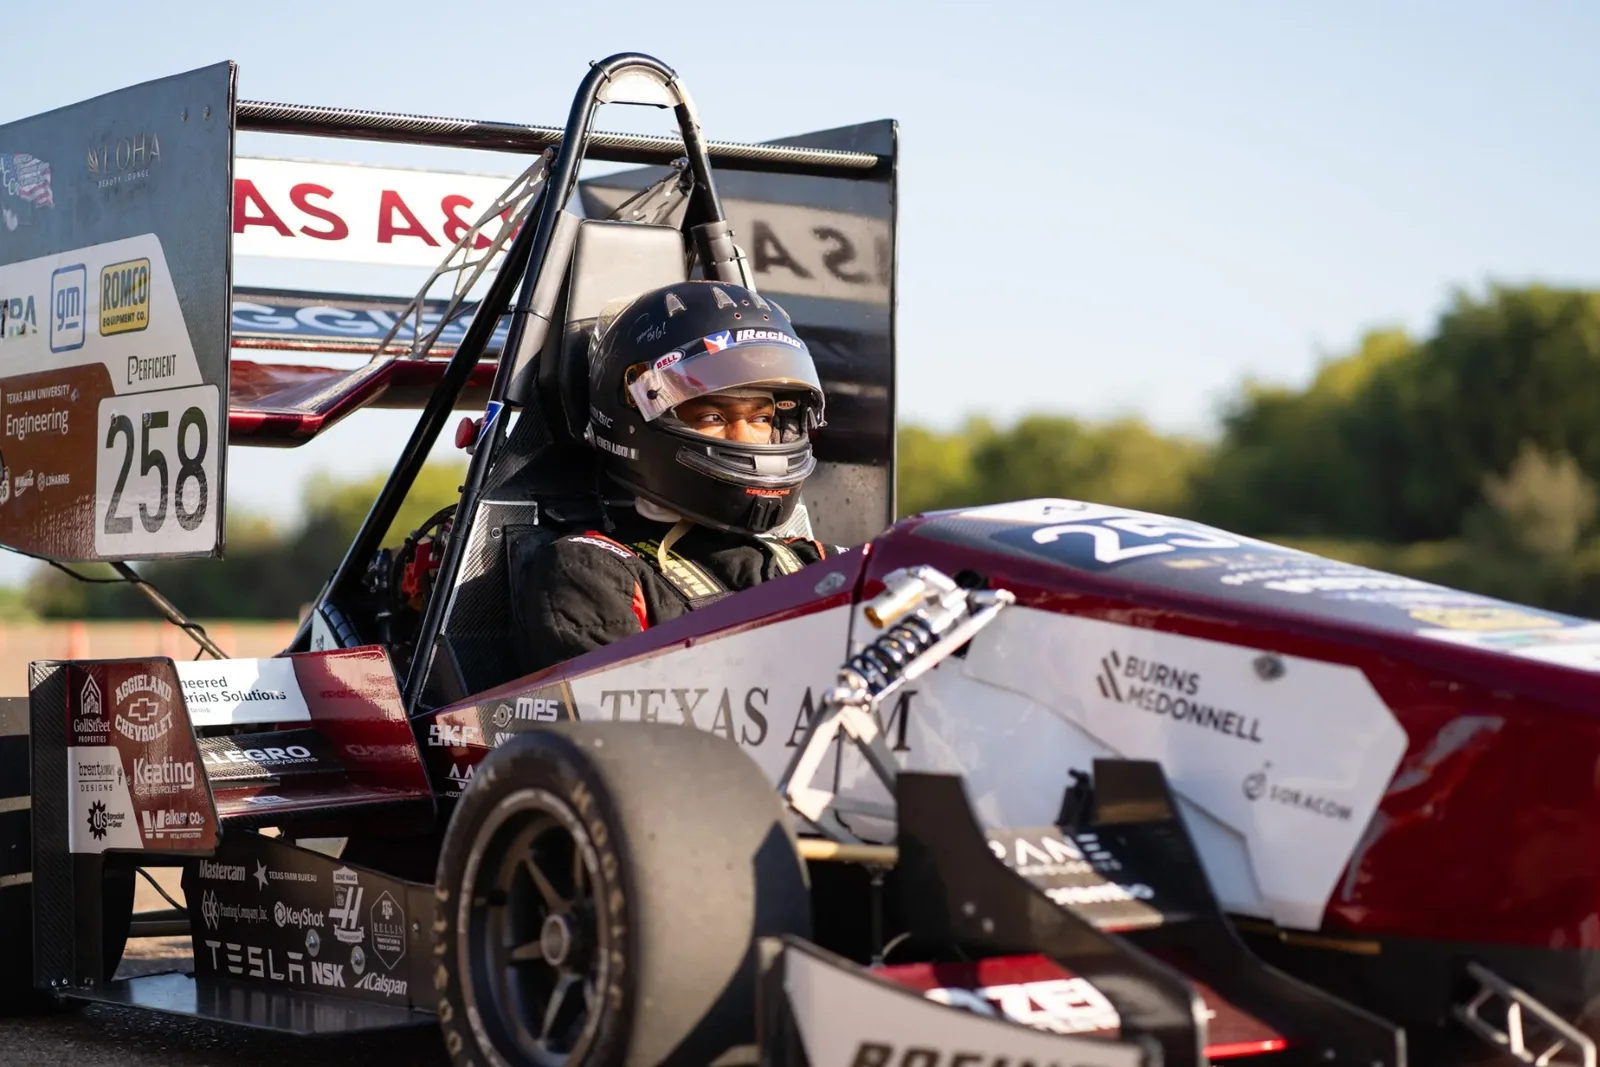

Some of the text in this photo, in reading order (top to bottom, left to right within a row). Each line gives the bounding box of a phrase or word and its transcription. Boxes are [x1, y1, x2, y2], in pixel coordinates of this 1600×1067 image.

[98, 168, 150, 189] BEAUTY LOUNGE
[232, 178, 520, 251] AS A&
[103, 265, 148, 312] ROMCO
[56, 286, 81, 331] gm
[102, 312, 146, 328] EQUIPMENT CO.
[735, 328, 802, 349] iRacing
[127, 354, 177, 385] PERFICIENT
[657, 354, 678, 370] BELL
[7, 384, 71, 404] TEXAS A&M UNIVERSITY
[6, 407, 69, 441] Engineering
[104, 406, 208, 535] 258
[181, 676, 228, 689] neered
[1124, 655, 1201, 696] BURNS
[115, 674, 173, 706] AGGIELAND
[185, 688, 287, 704] erials Solutions
[515, 697, 558, 722] MPS
[600, 687, 768, 747] TEXAS
[114, 710, 173, 742] CHEVROLET
[428, 724, 479, 748] SKF
[78, 735, 107, 743] PROPERTIES
[133, 753, 195, 790] Keating
[243, 757, 319, 767] microsystems
[80, 784, 113, 792] DESIGNS
[445, 790, 462, 798] ADDIT
[93, 809, 108, 829] US
[199, 859, 247, 882] Mastercam
[268, 870, 318, 883] TEXAS FARM BUREAU
[286, 906, 325, 929] KeyShot
[205, 939, 305, 985] TESLA
[311, 960, 347, 988] NSK
[368, 972, 408, 997] Calspan
